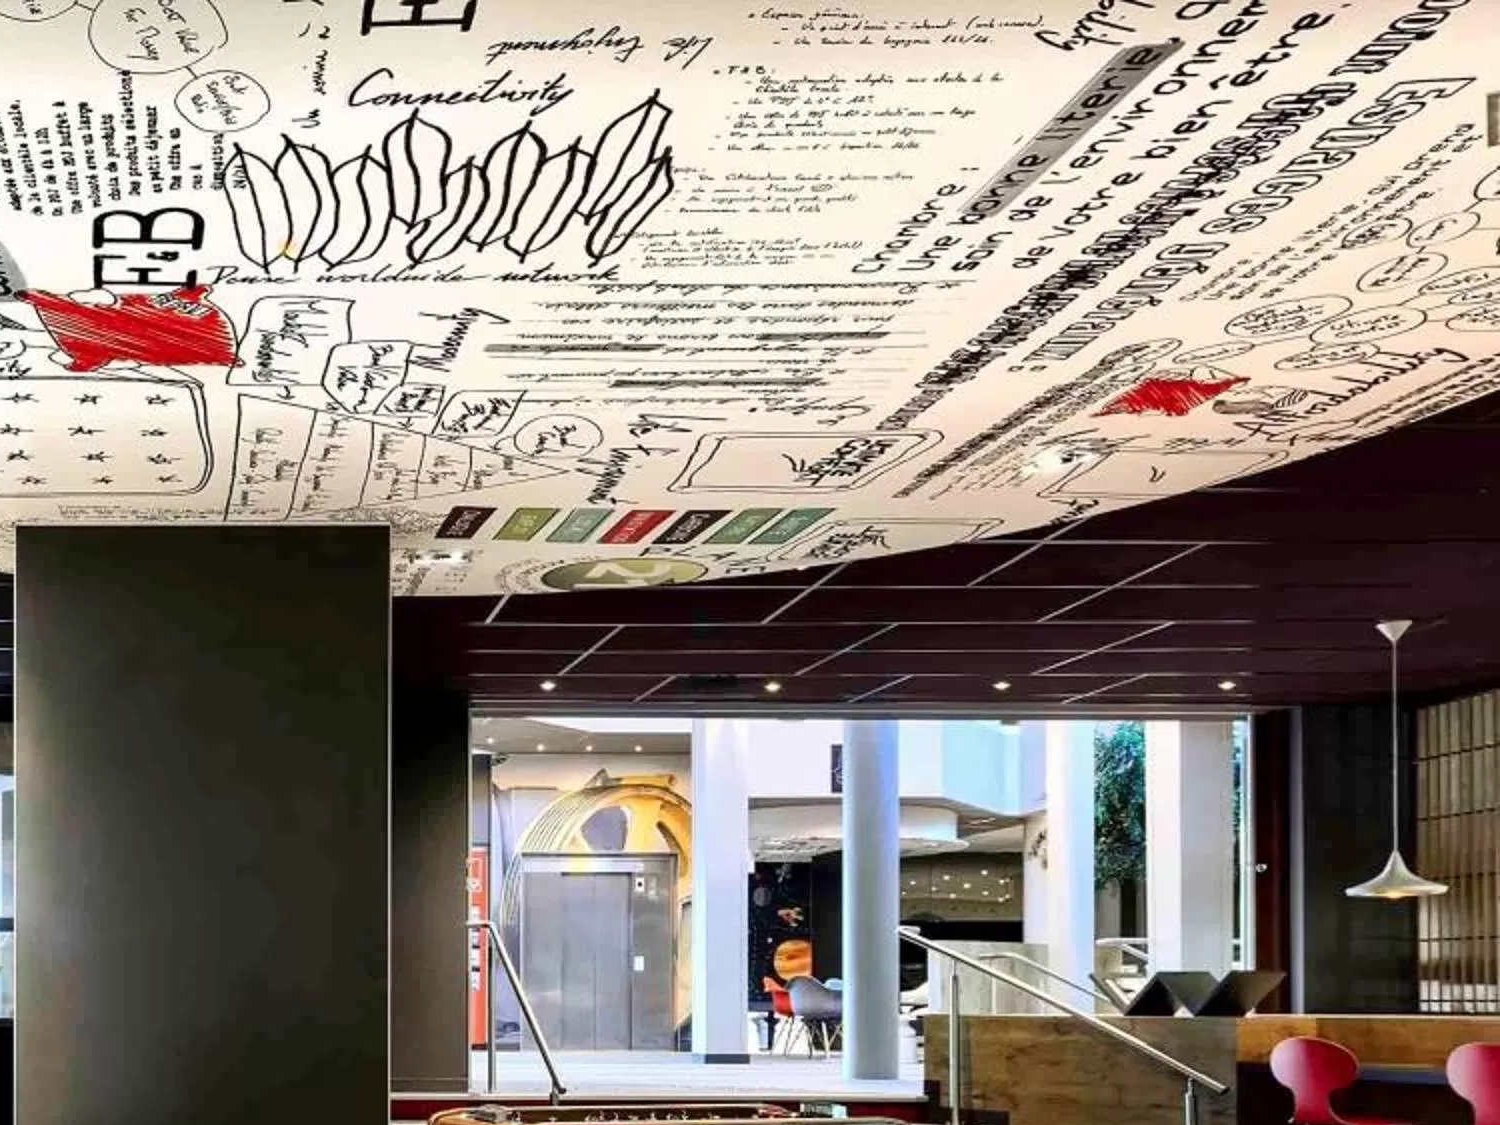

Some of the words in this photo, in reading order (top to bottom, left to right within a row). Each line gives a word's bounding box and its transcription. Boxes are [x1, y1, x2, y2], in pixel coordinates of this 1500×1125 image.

[348, 68, 576, 117] Connectivity
[900, 235, 964, 272] Une
[946, 154, 1051, 227] bonne
[1036, 35, 1183, 144] literie,
[1012, 245, 1054, 270] de
[1130, 99, 1235, 162] bien
[1200, 77, 1477, 235] Espaces
[490, 262, 620, 284] network
[852, 182, 966, 274] Chambre
[951, 231, 1013, 272] soin
[1008, 195, 1053, 223] de
[1234, 348, 1470, 445] Affordability
